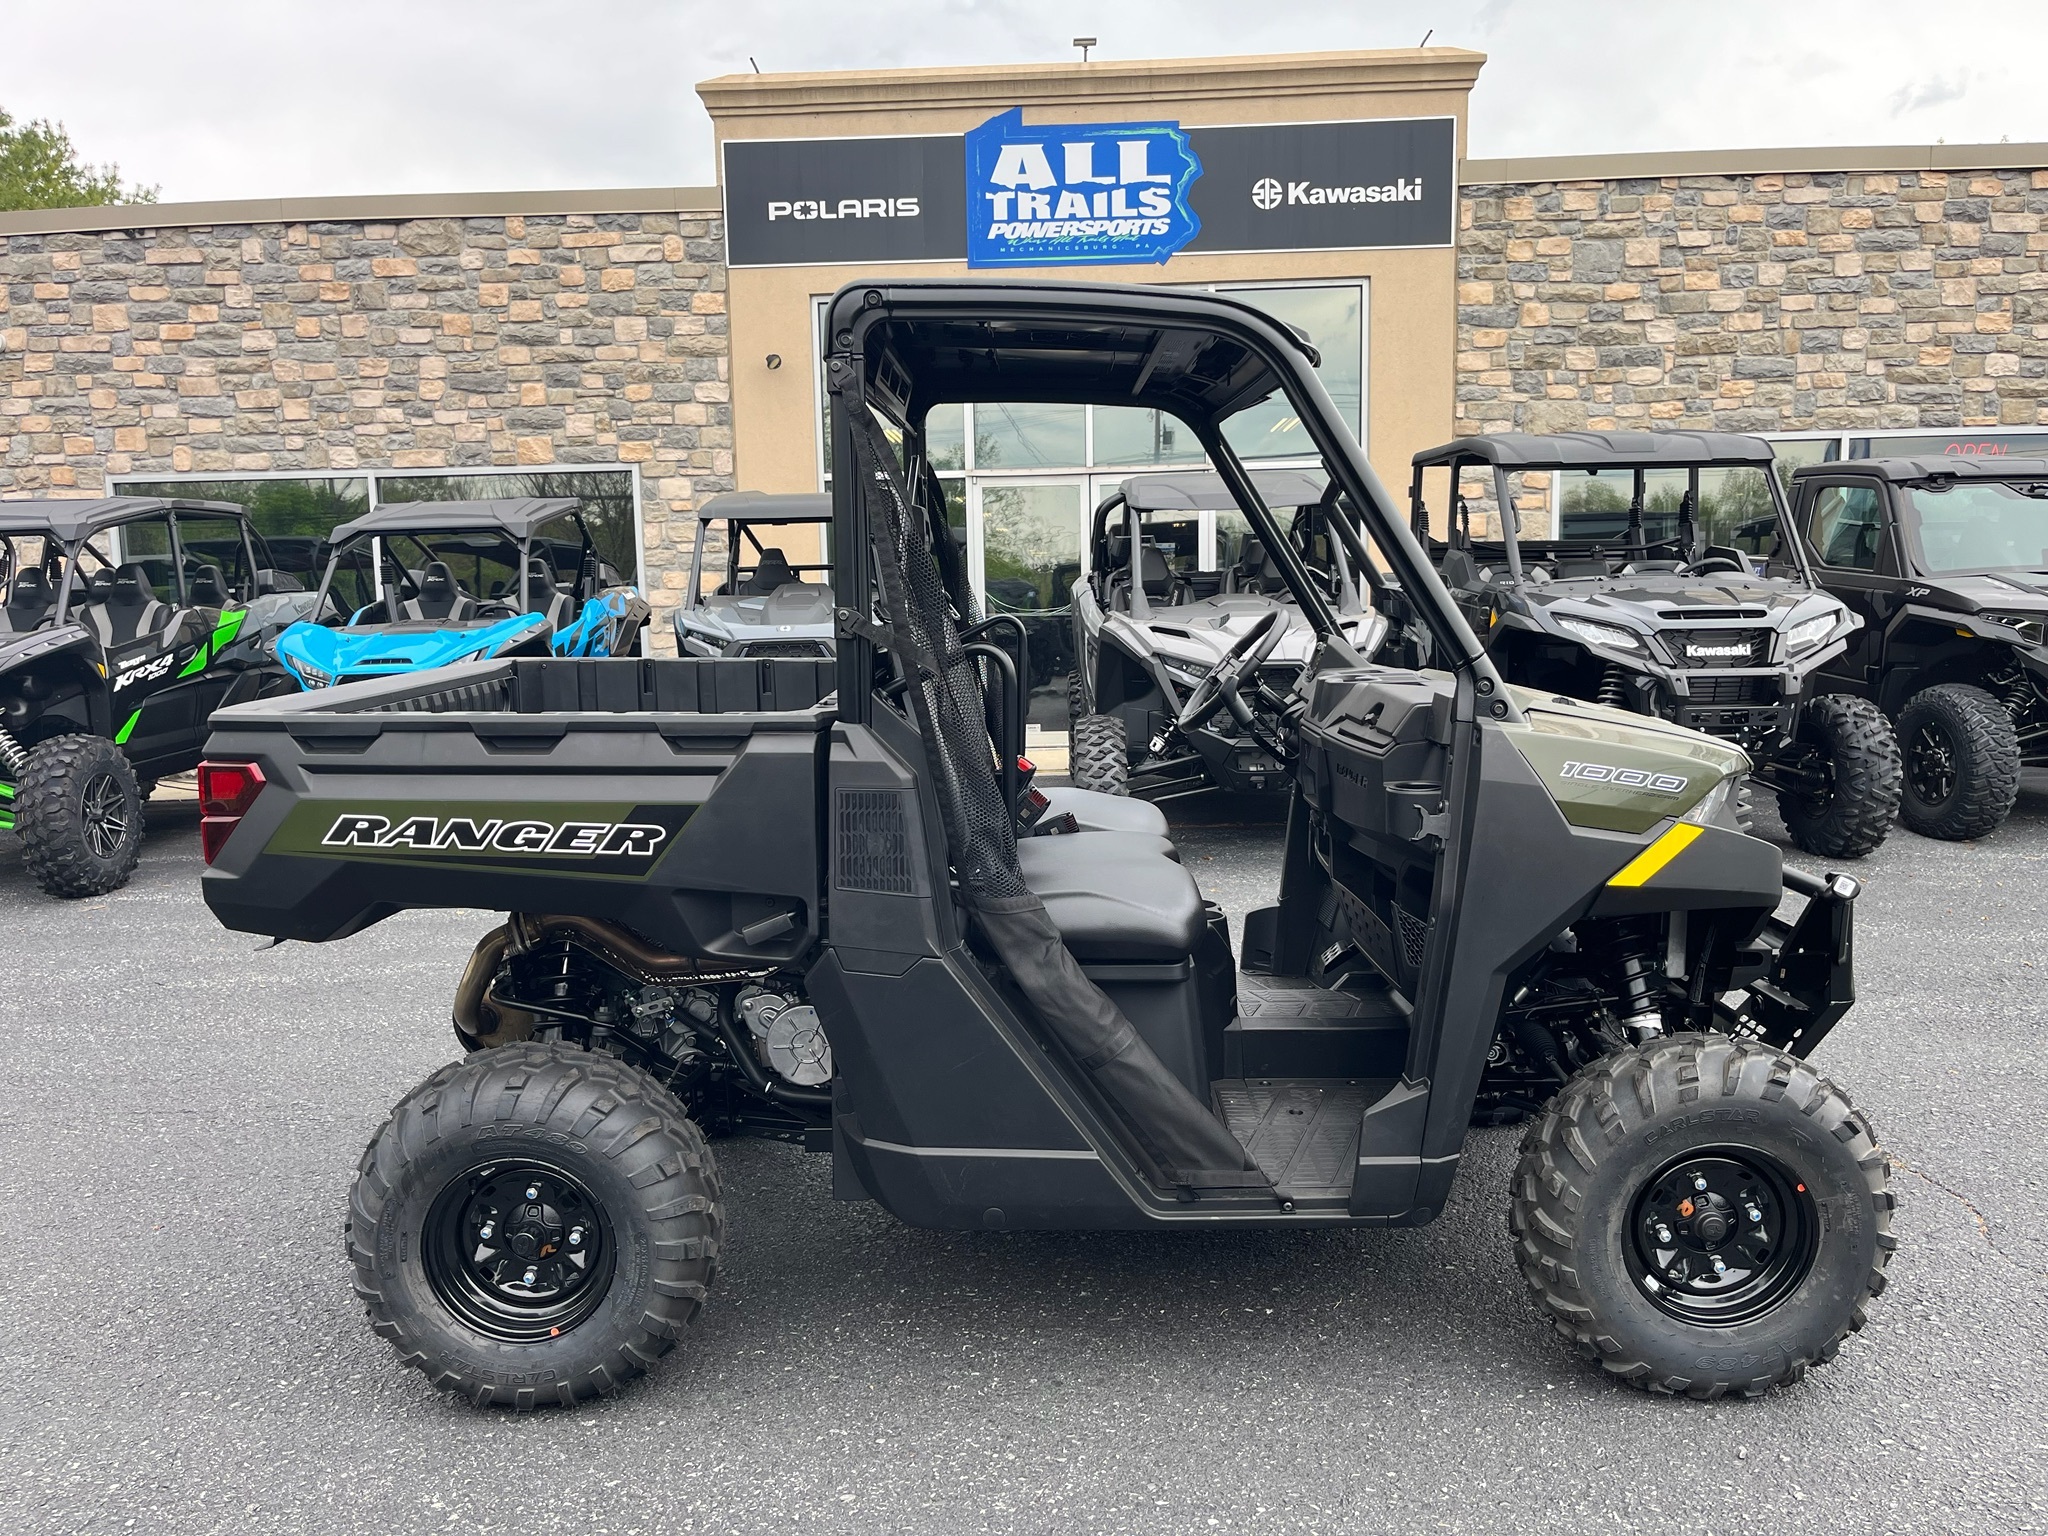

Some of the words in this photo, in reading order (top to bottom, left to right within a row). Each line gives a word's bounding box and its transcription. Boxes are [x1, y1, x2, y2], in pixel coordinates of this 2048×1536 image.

[989, 140, 1171, 190] ALL
[985, 187, 1172, 220] TRAILS
[1288, 177, 1422, 205] Kawasaki
[768, 197, 920, 221] POLARIS
[987, 218, 1171, 239] POWERSPORTS
[1905, 586, 1931, 598] XP
[1686, 643, 1752, 657] Kawasaki
[148, 667, 169, 681] 1000
[1559, 761, 1688, 793] 1000
[321, 814, 667, 856] RANGER
[1644, 1107, 1761, 1146] CARLSTAR
[439, 1350, 557, 1384] CARLSTAR
